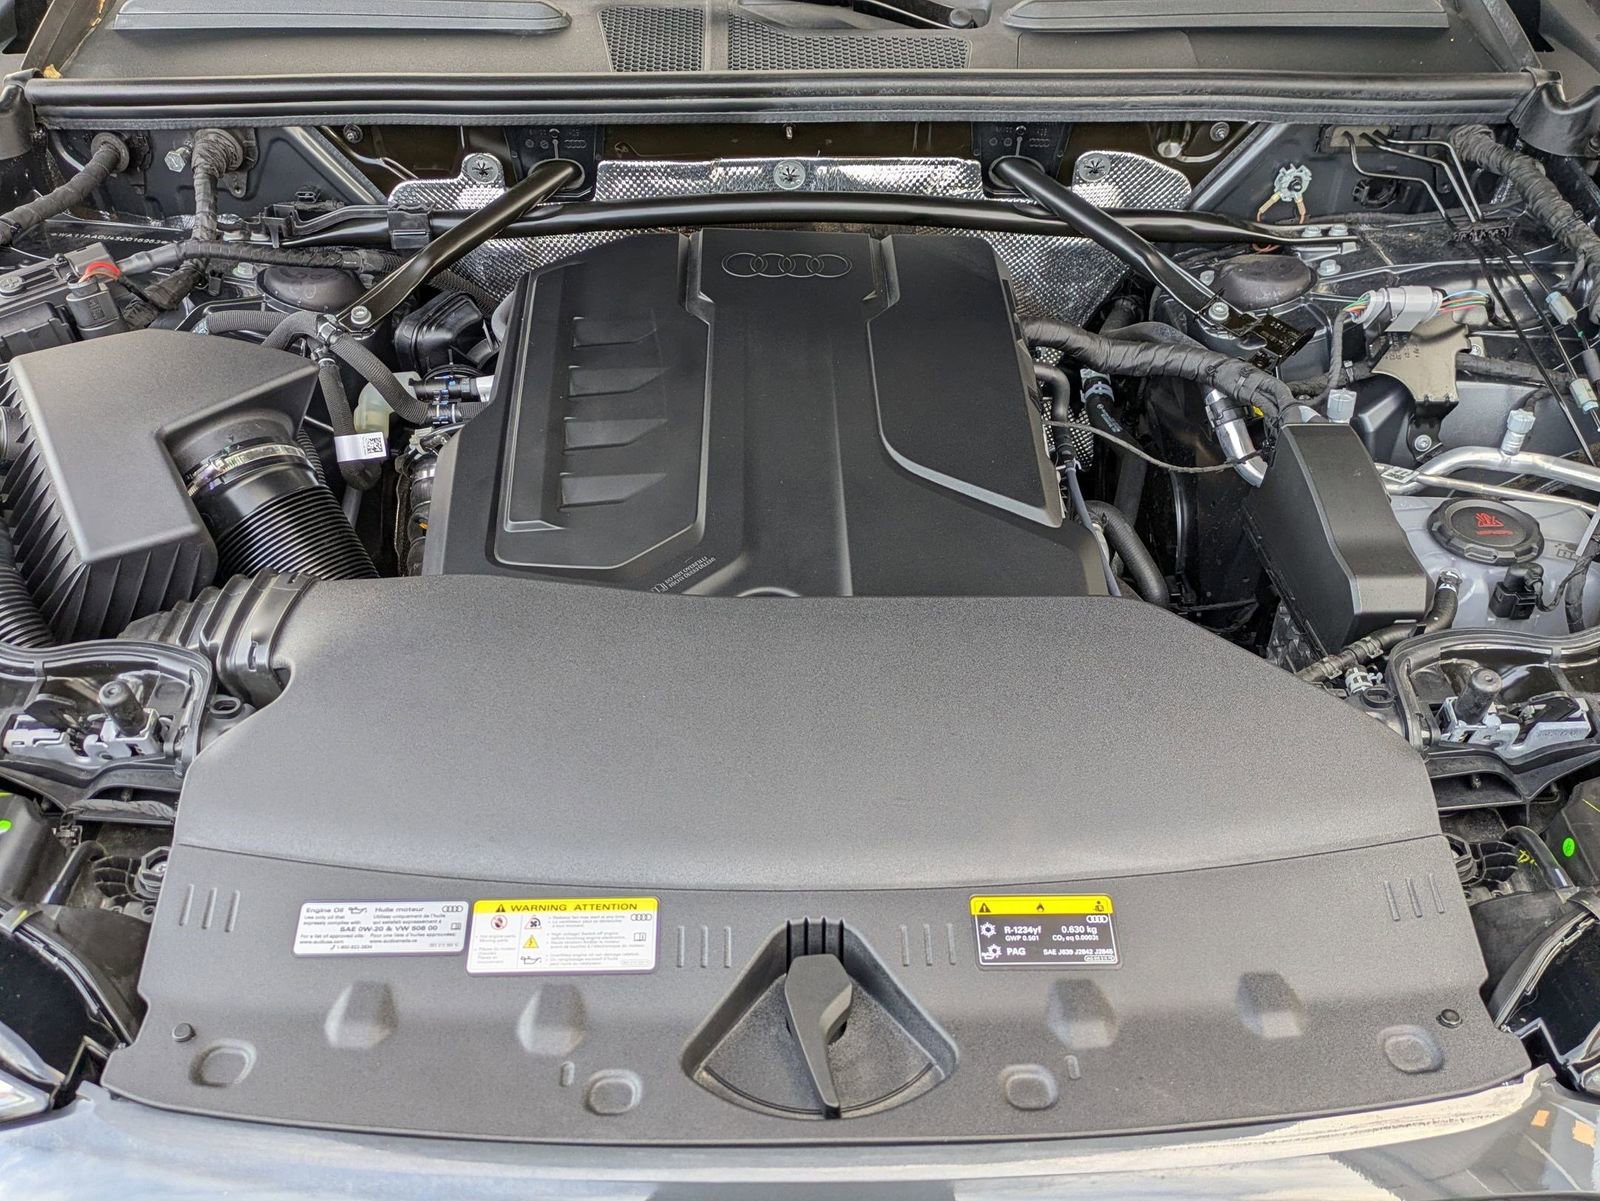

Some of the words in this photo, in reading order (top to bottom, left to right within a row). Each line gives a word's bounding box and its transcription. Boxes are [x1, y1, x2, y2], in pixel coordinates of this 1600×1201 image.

[574, 903, 638, 911] ATTENTION
[1004, 926, 1042, 935] R-1234yf
[1061, 926, 1085, 934] 0.630
[1086, 926, 1098, 934] kg
[1006, 948, 1026, 956] PAG
